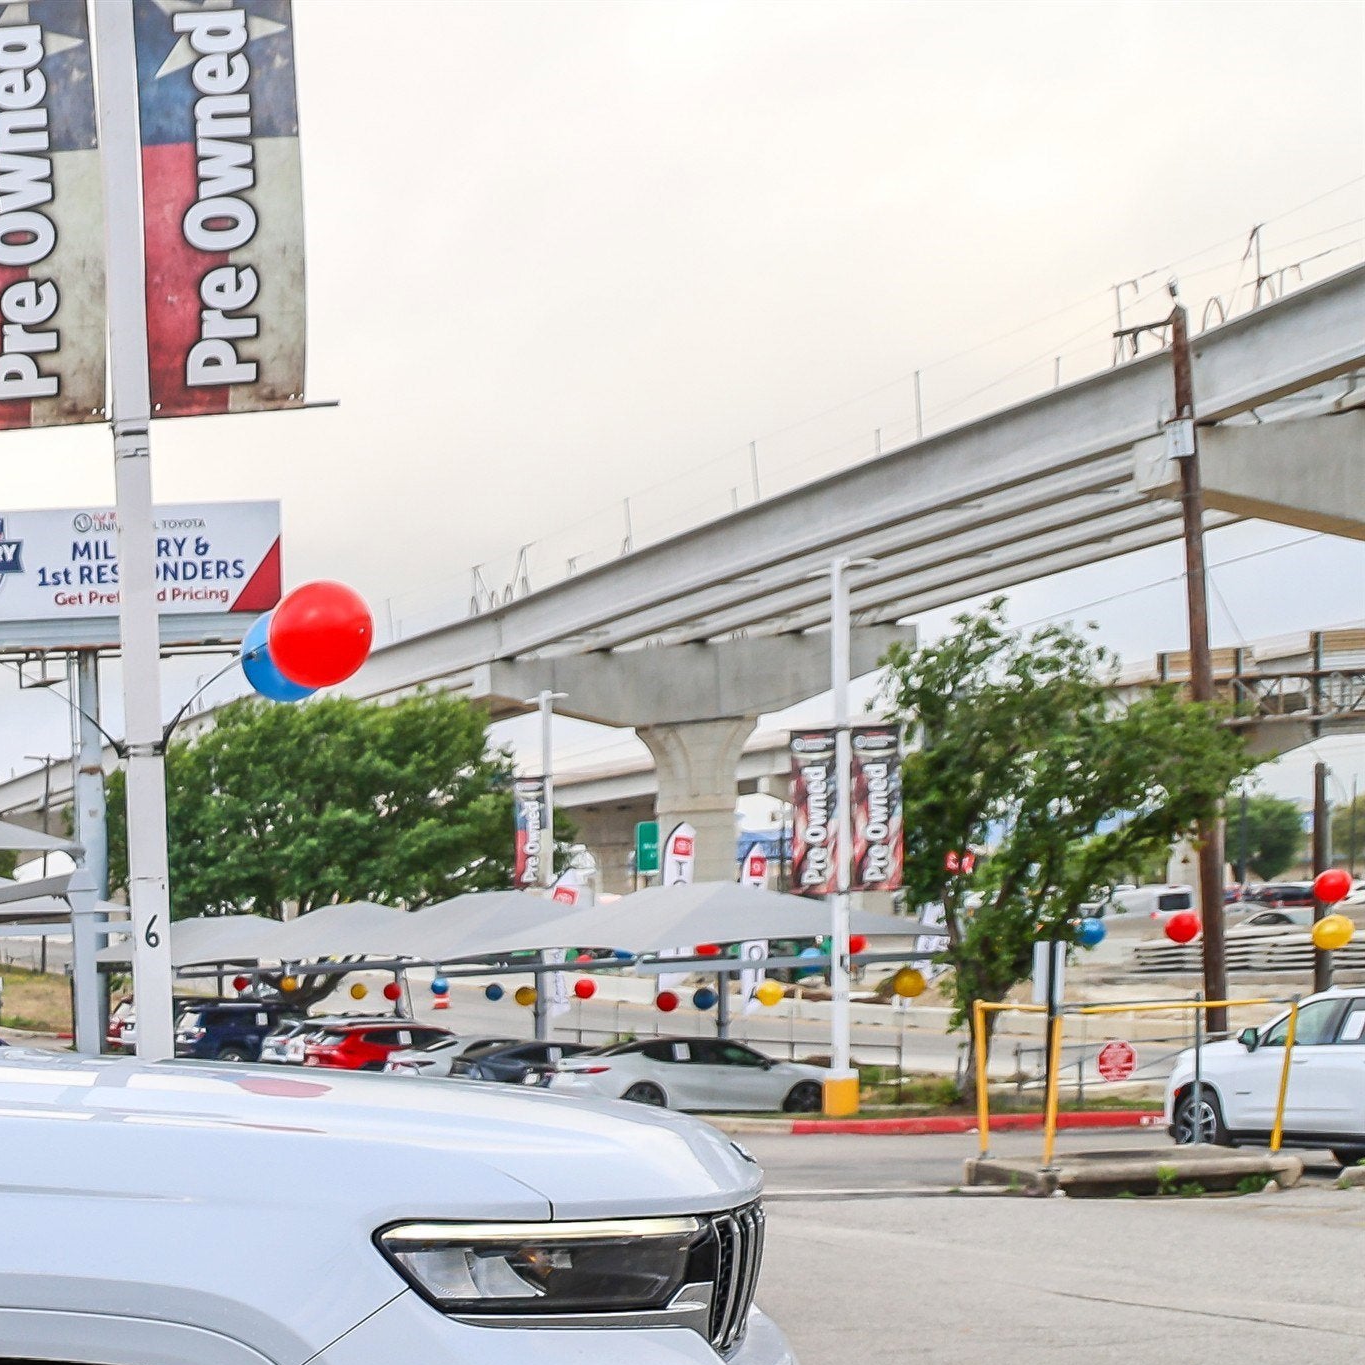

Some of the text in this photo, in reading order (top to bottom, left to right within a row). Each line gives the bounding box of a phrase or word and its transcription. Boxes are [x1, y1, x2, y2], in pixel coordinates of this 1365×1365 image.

[173, 8, 260, 387] Pre Owned
[162, 518, 206, 529] TOYOTA
[72, 536, 210, 561] MILRY &
[38, 566, 72, 587] 1st
[55, 592, 83, 606] Get
[172, 585, 229, 604] Pricing
[801, 765, 828, 844] Owned
[863, 763, 889, 841] Owned
[801, 847, 828, 885] Pre
[863, 844, 889, 882] Pre
[145, 914, 160, 948] 6
